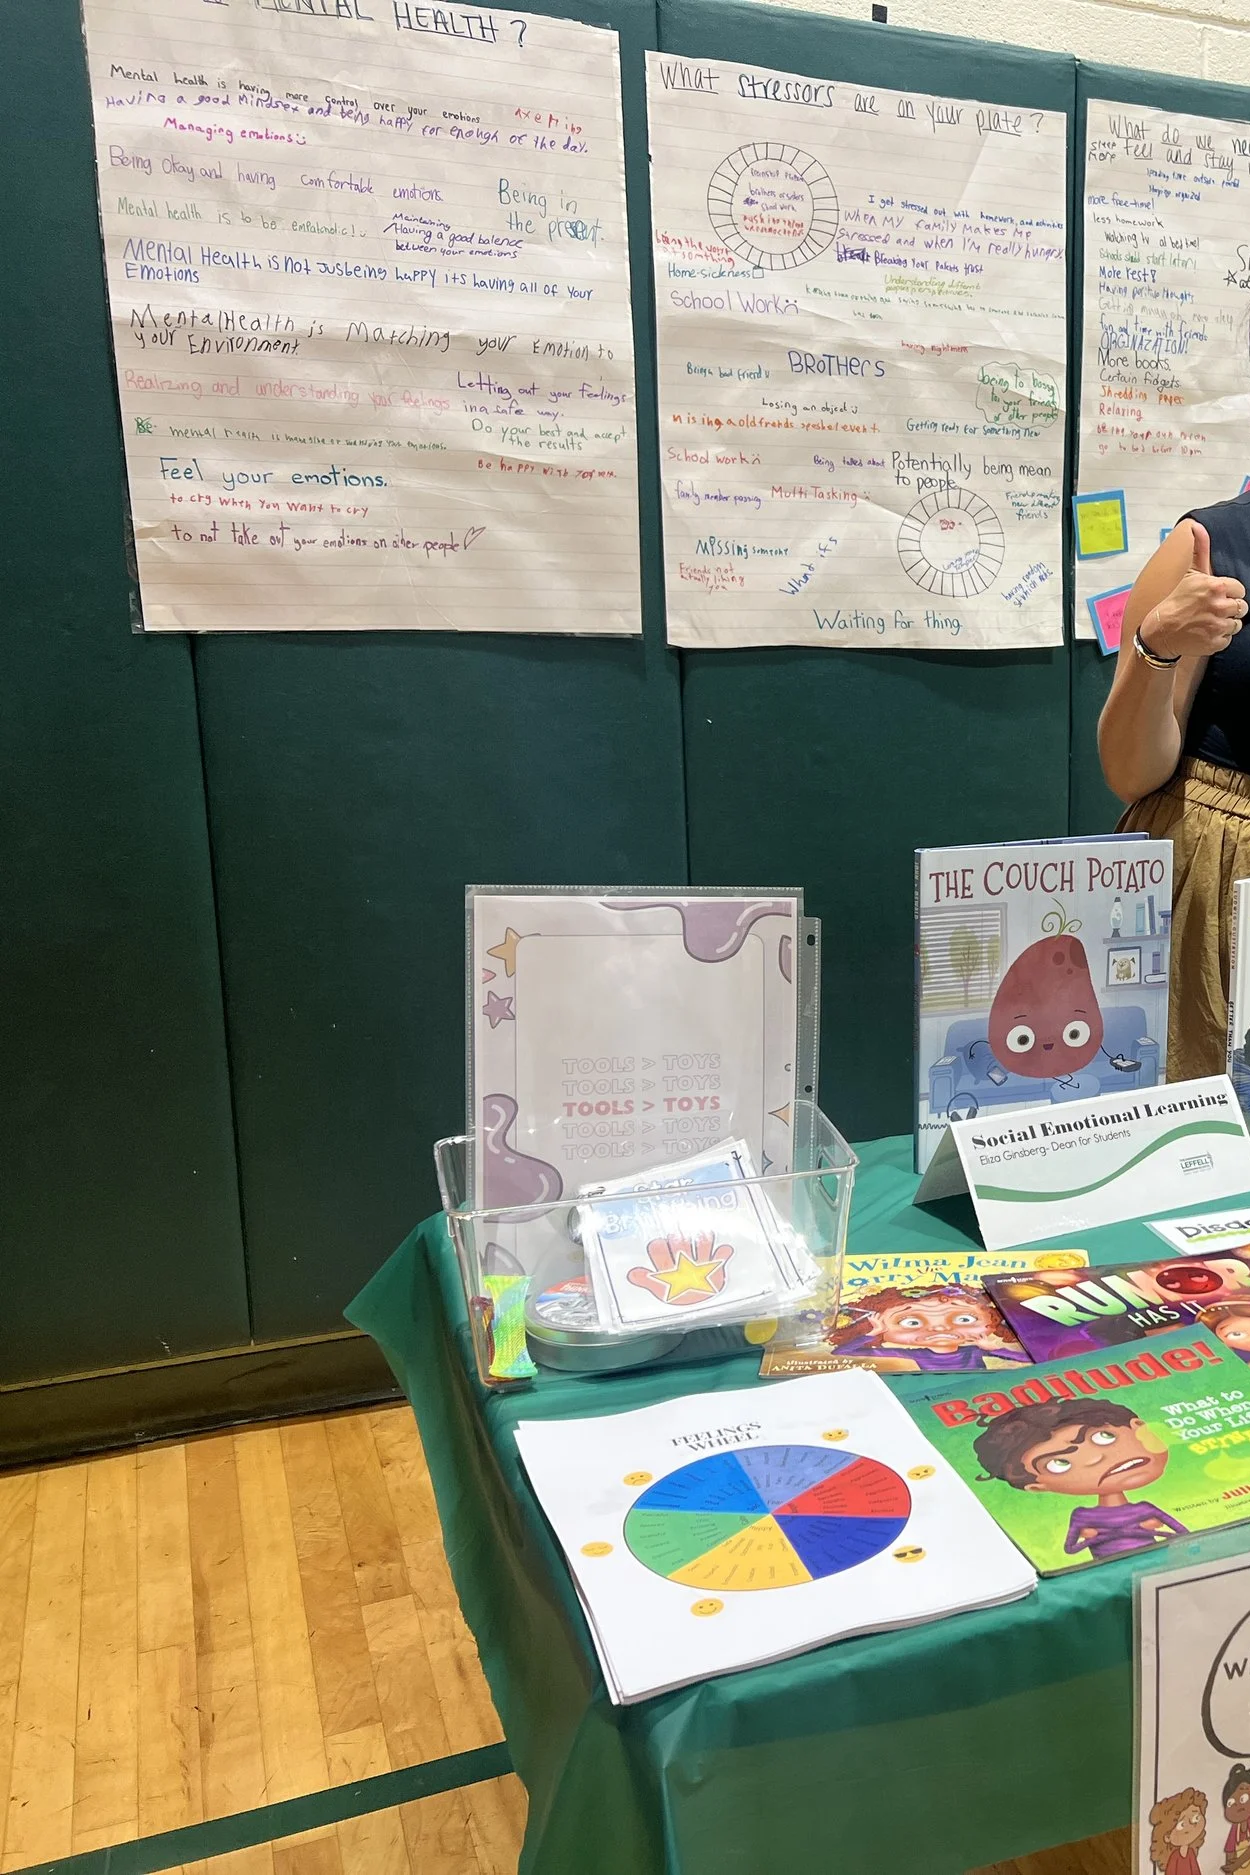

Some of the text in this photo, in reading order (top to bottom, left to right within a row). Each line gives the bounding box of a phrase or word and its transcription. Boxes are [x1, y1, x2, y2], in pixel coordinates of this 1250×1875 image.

[393, 1, 527, 47] HEALTH ?
[660, 62, 1044, 137] What stressors are on your plate ?
[1109, 115, 1150, 141] What
[1161, 124, 1182, 147] do
[1196, 135, 1215, 151] we
[1166, 148, 1193, 165] and
[1204, 152, 1234, 181] stay
[160, 457, 388, 491] Feel your emotions.
[891, 450, 1051, 482] Potentially being mean
[896, 470, 911, 486] to
[813, 609, 886, 633] Waiting
[894, 610, 915, 628] for
[929, 857, 1165, 903] THE COUCH POTATO
[562, 1053, 721, 1075] TOOLS TOYS
[562, 1075, 721, 1096] TOOLS TOYS
[562, 1096, 721, 1117] TOOLS TOYS
[562, 1116, 721, 1139] TOOLS TOYS
[971, 1093, 1229, 1150] Social Emotional Learning
[979, 1154, 1001, 1165] Eliza
[1051, 1140, 1077, 1152] Dean
[1079, 1136, 1091, 1147] for
[1093, 1129, 1131, 1144] Students
[1181, 1158, 1210, 1169] LEFFELL
[848, 1255, 1028, 1272] Wilma Jean
[1127, 1305, 1181, 1328] HAS
[930, 1340, 1224, 1428] Baditude!
[1160, 1390, 1245, 1416] What to
[672, 1422, 761, 1446] FEELINGS
[1165, 1416, 1196, 1429] Do
[1172, 1423, 1223, 1441] Your
[688, 1432, 759, 1451] WHEEL
